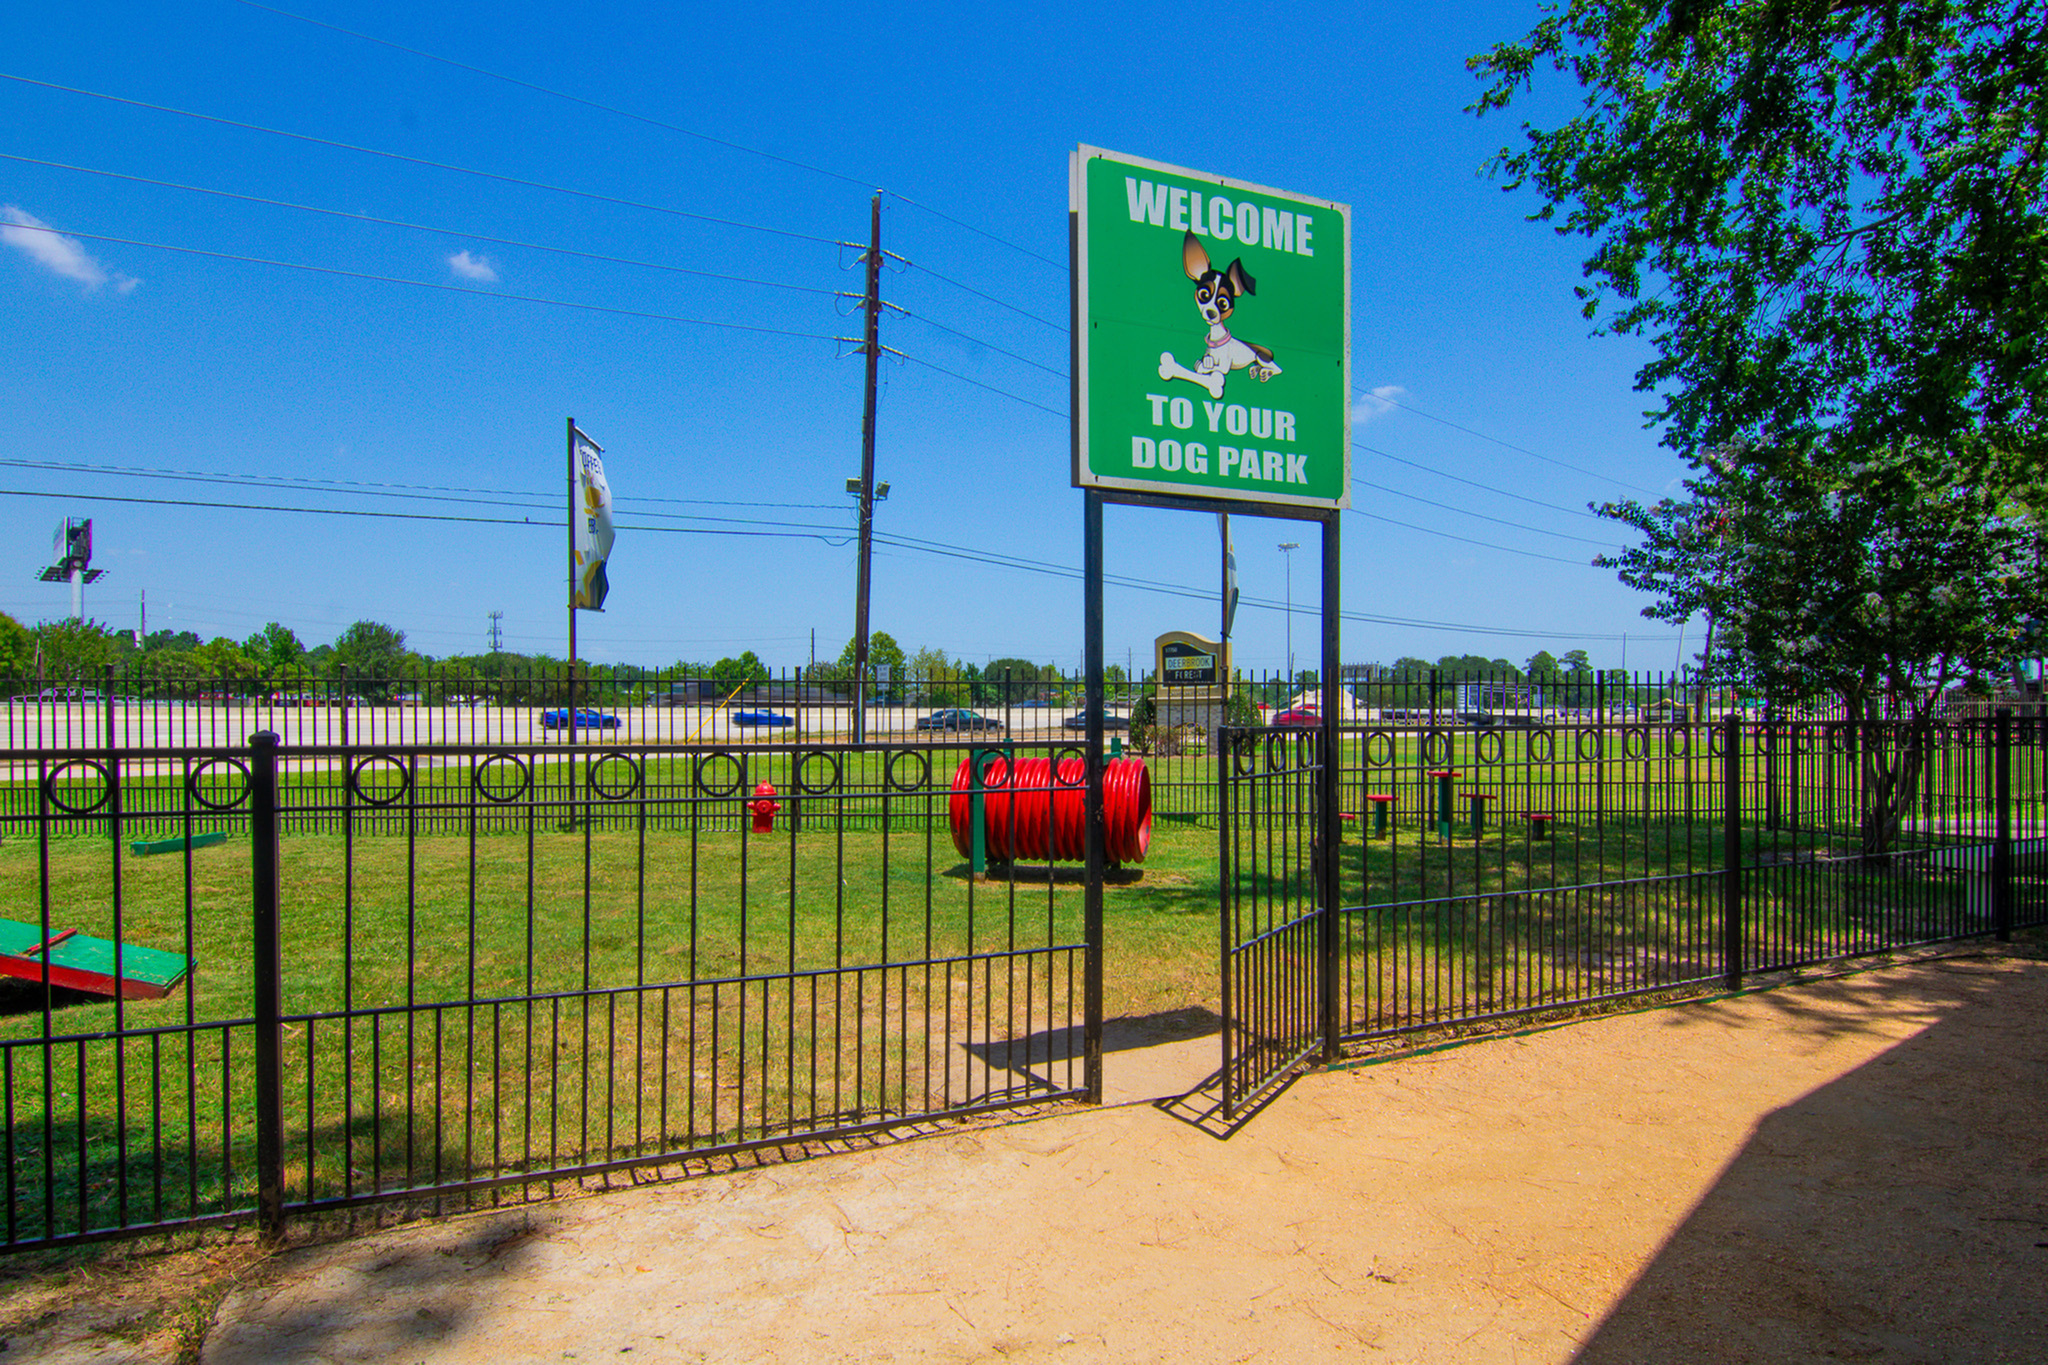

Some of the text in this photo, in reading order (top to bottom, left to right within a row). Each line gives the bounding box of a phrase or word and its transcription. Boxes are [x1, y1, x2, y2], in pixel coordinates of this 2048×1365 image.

[1125, 177, 1313, 257] WELCOME
[1146, 393, 1296, 442] TO YOUR
[1131, 436, 1308, 485] DOG PARK
[1168, 658, 1210, 668] DEERBROOK
